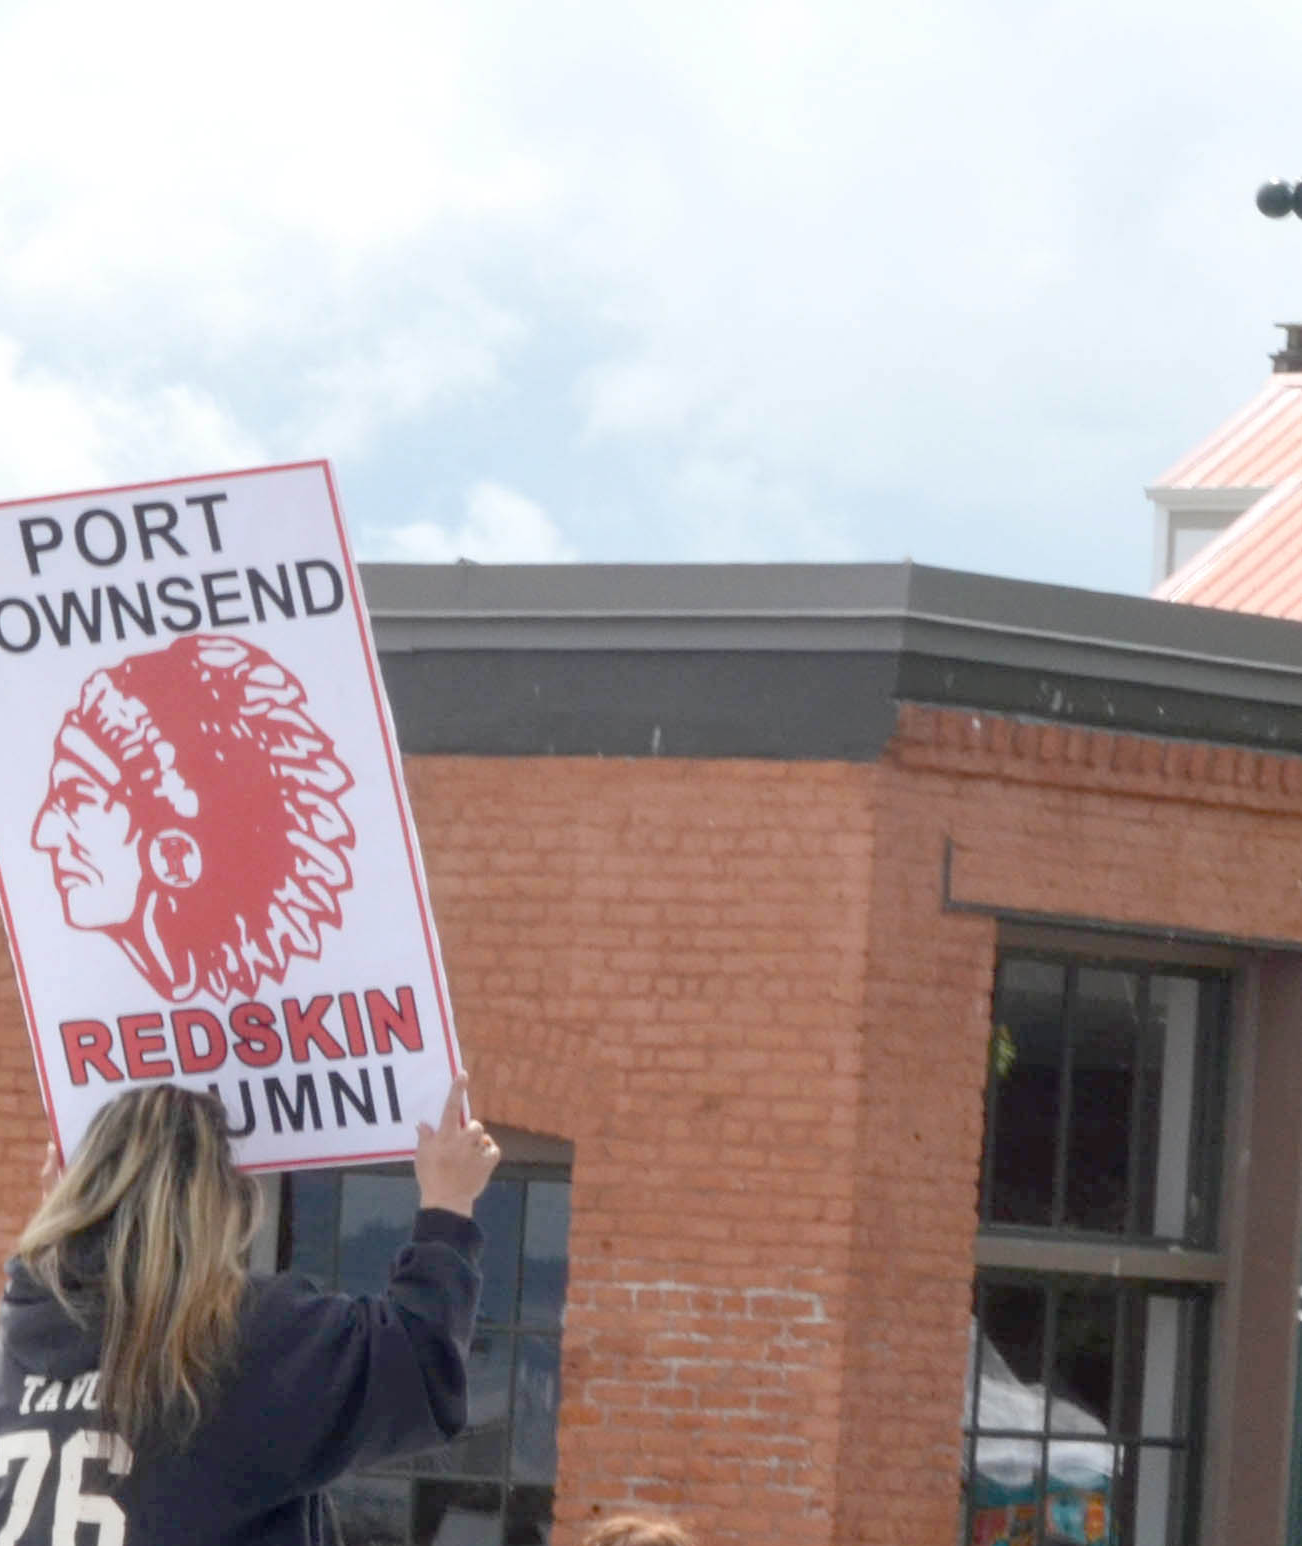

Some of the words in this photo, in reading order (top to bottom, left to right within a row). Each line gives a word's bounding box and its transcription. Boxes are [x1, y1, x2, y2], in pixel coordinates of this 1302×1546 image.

[19, 492, 228, 577] PORT
[59, 984, 424, 1086] REDSKIN
[208, 1064, 403, 1139] UMNI
